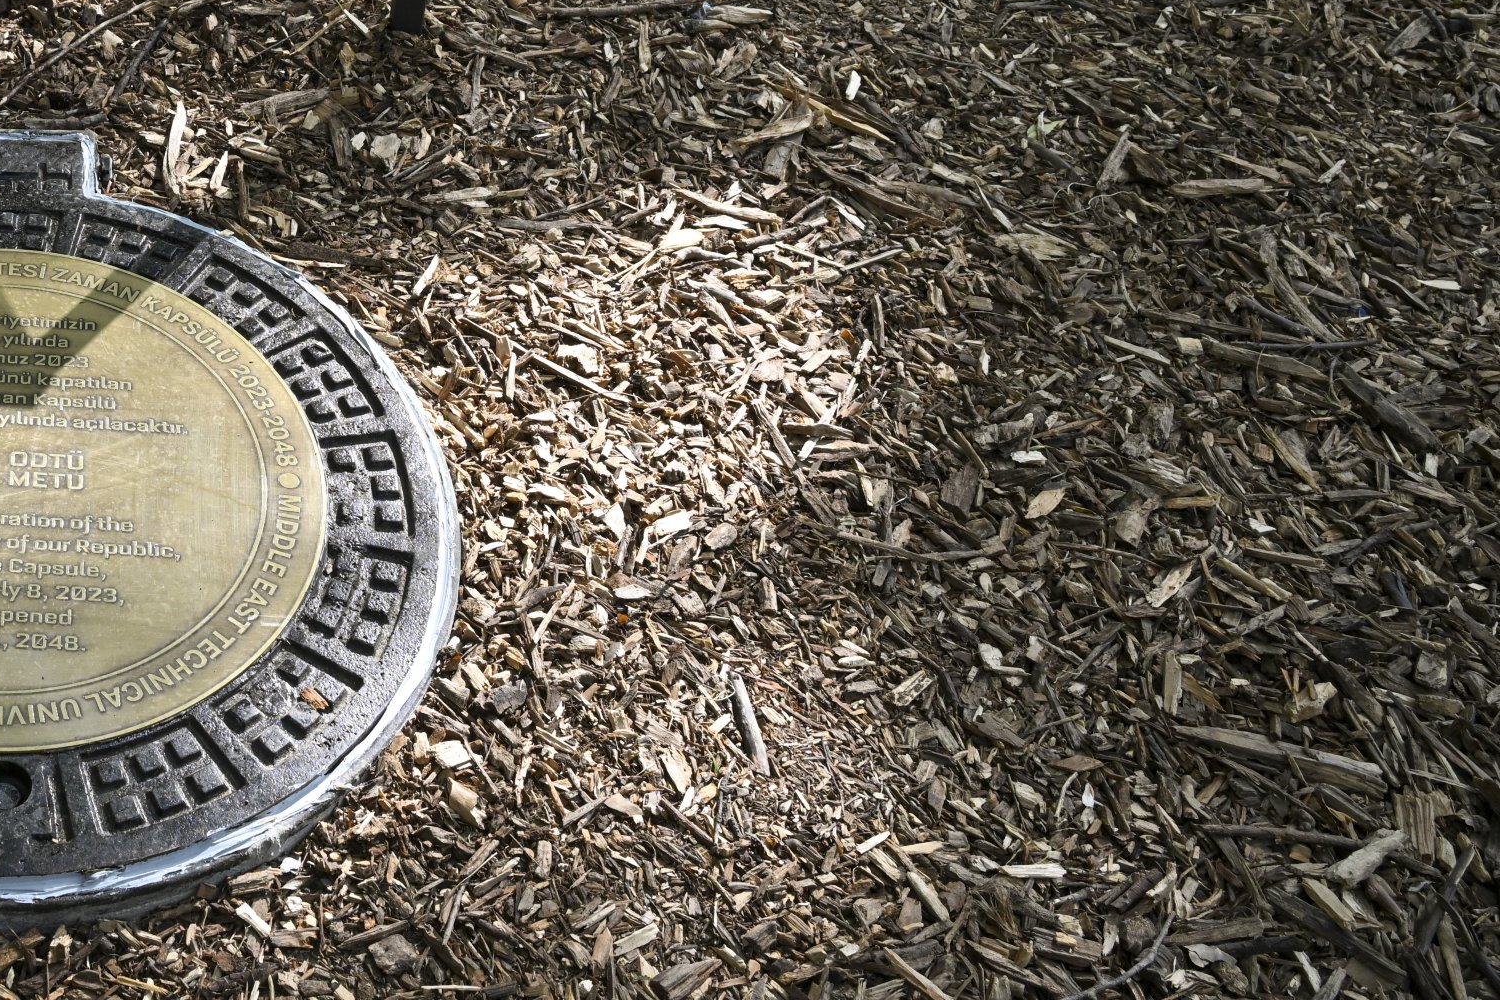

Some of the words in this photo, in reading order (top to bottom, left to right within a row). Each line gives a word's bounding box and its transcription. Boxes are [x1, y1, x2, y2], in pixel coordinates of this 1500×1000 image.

[4, 333, 69, 349] yılında
[34, 354, 89, 368] 2023
[51, 268, 140, 302] ZAMAN
[141, 296, 240, 364] KAPSÜLÜ
[228, 363, 298, 467] 2023-2048
[38, 373, 132, 392] kapatılan
[33, 394, 116, 411] Kapsülü
[0, 412, 68, 428] yılında
[73, 417, 188, 434] açılacaktır.
[9, 451, 84, 470] ODTÜ
[8, 472, 84, 489] METU
[71, 516, 93, 533] of
[98, 517, 134, 532] the
[262, 494, 301, 578] MIDDLE
[7, 535, 27, 554] of
[34, 539, 71, 552] our
[76, 539, 181, 561] Republic,
[9, 559, 107, 580] Capsule,
[27, 585, 48, 600] 8,
[55, 586, 125, 606] 2023,
[228, 577, 277, 635] EAST
[16, 634, 86, 651] 2048.
[83, 630, 236, 712] TECHNICAL
